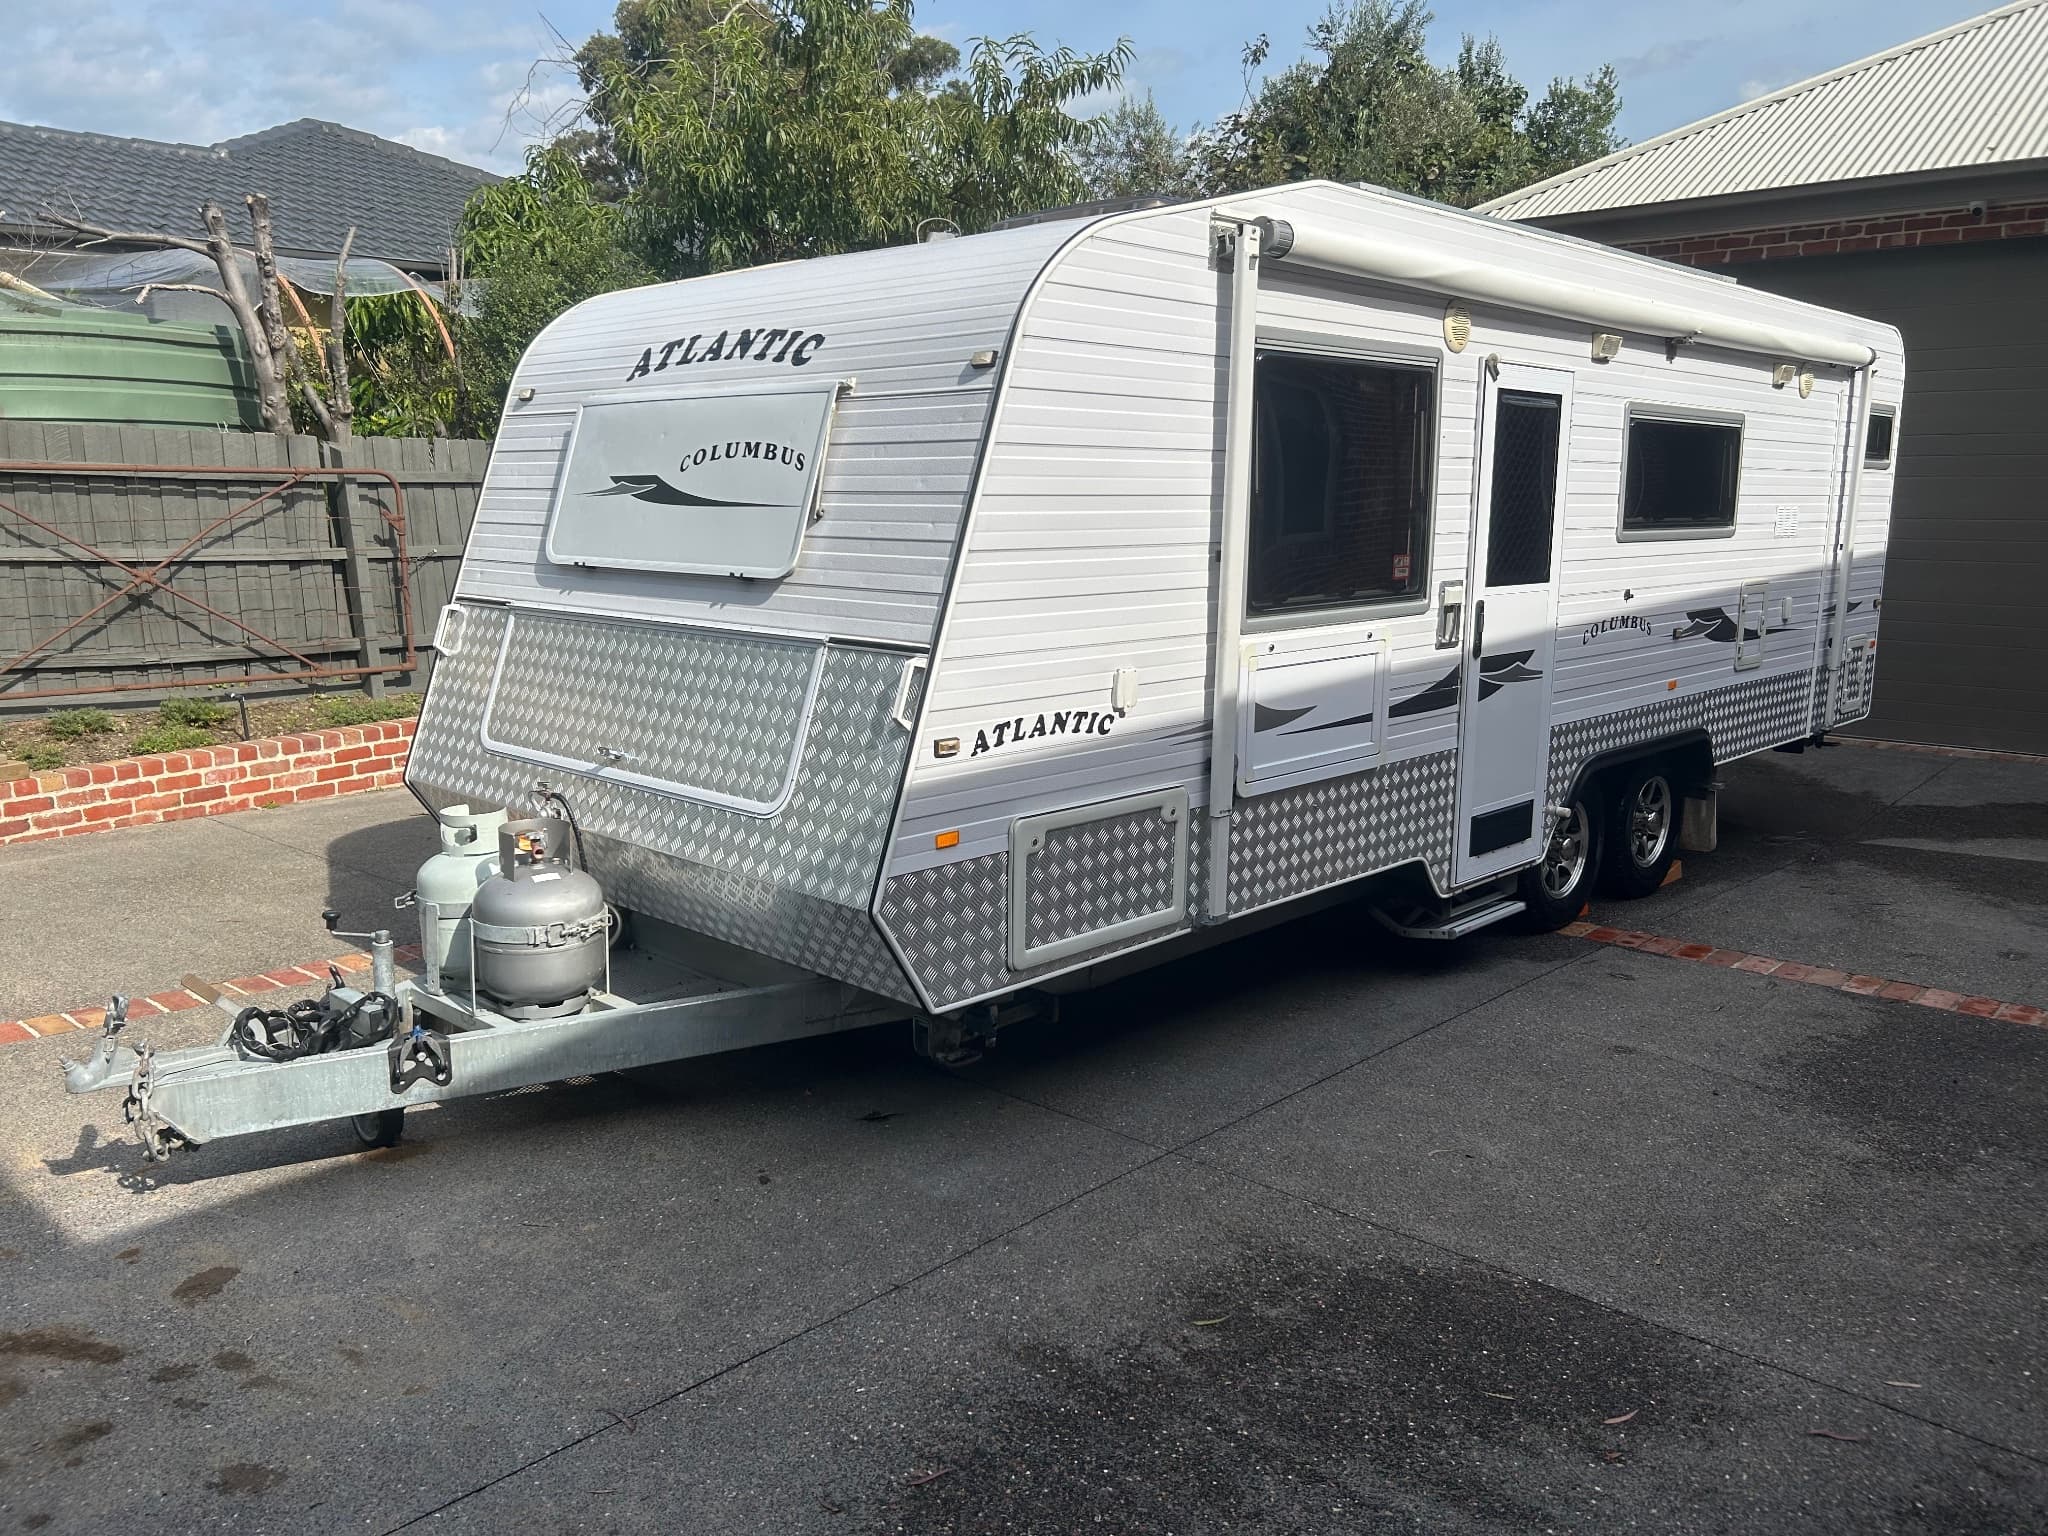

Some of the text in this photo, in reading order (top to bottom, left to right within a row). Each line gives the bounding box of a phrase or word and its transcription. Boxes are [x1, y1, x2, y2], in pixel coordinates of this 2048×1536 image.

[626, 328, 826, 382] ATLANTIC
[680, 441, 806, 472] COLUMBUS
[1582, 615, 1652, 646] COLUMBUS
[970, 711, 1115, 757] ATLANTIC
